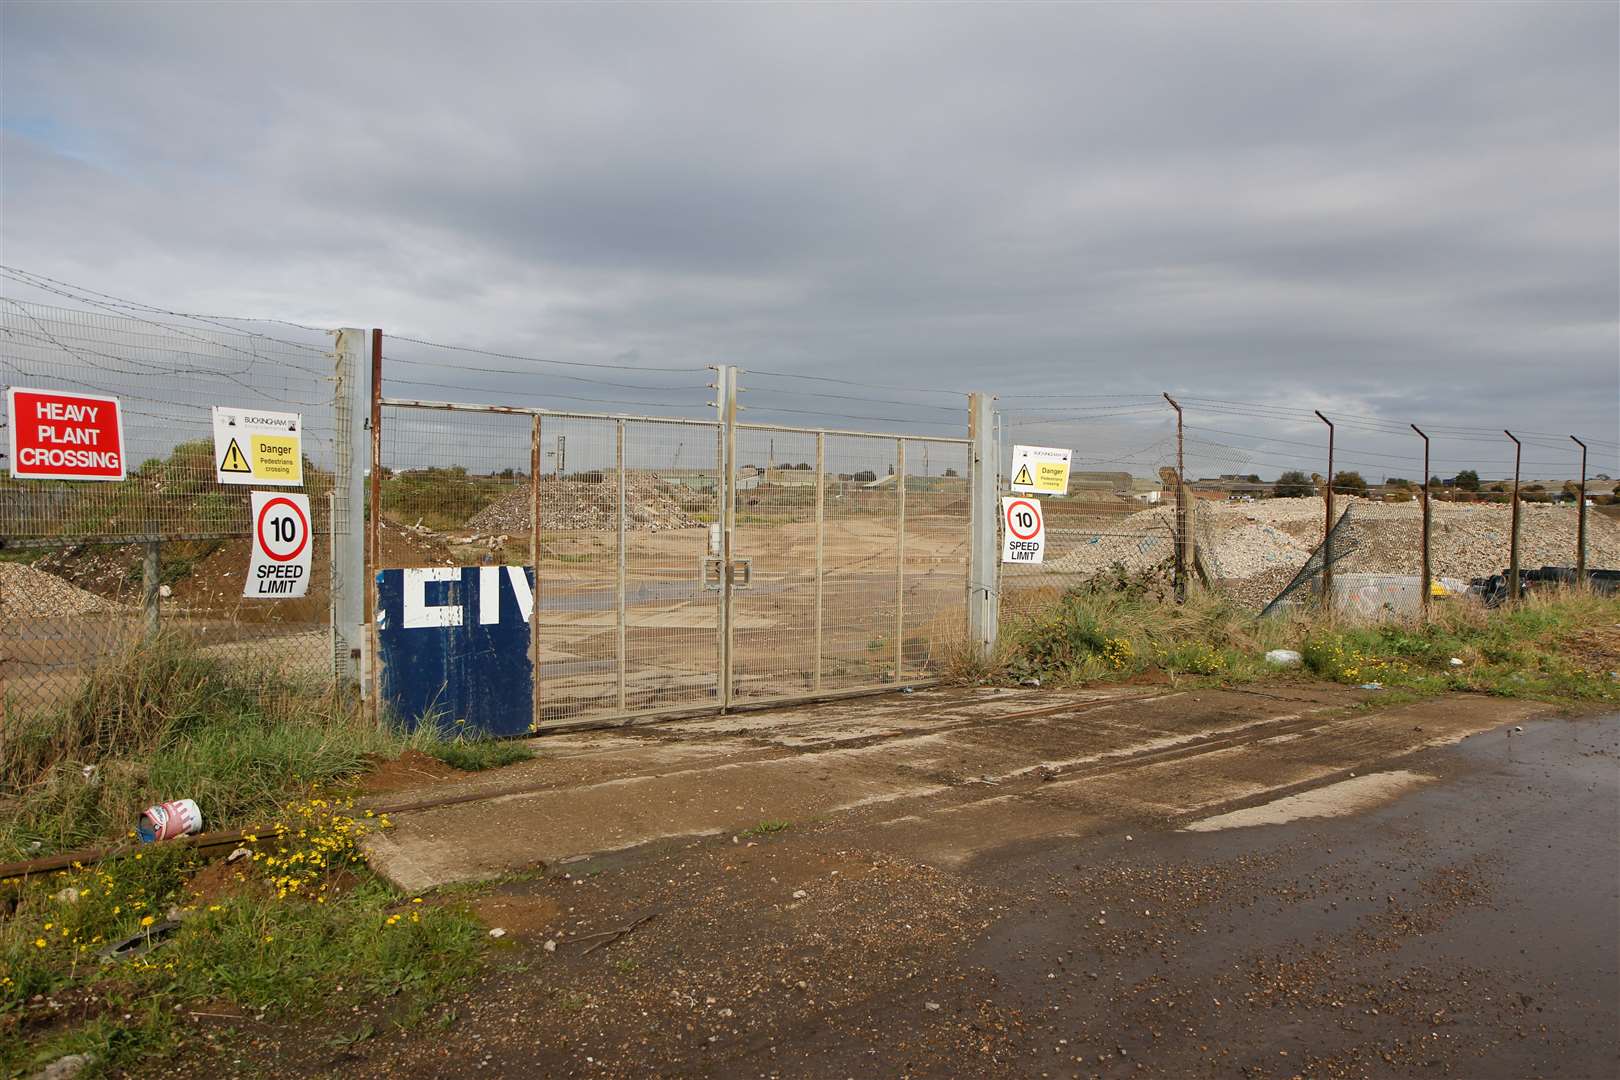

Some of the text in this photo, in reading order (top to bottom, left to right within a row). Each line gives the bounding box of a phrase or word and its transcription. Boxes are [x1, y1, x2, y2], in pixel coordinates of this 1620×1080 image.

[36, 401, 98, 423] HEAVY
[244, 416, 287, 426] BUCKINGHAM
[38, 425, 100, 445] PLANT
[260, 443, 292, 456] Danger
[20, 447, 119, 469] CROSSING
[1041, 467, 1064, 476] Danger
[1015, 512, 1033, 528] 10
[270, 516, 296, 542] 10
[1009, 541, 1040, 551] SPEED
[1011, 551, 1036, 561] LIMIT
[257, 564, 303, 579] SPEED
[258, 580, 297, 594] LIMIT
